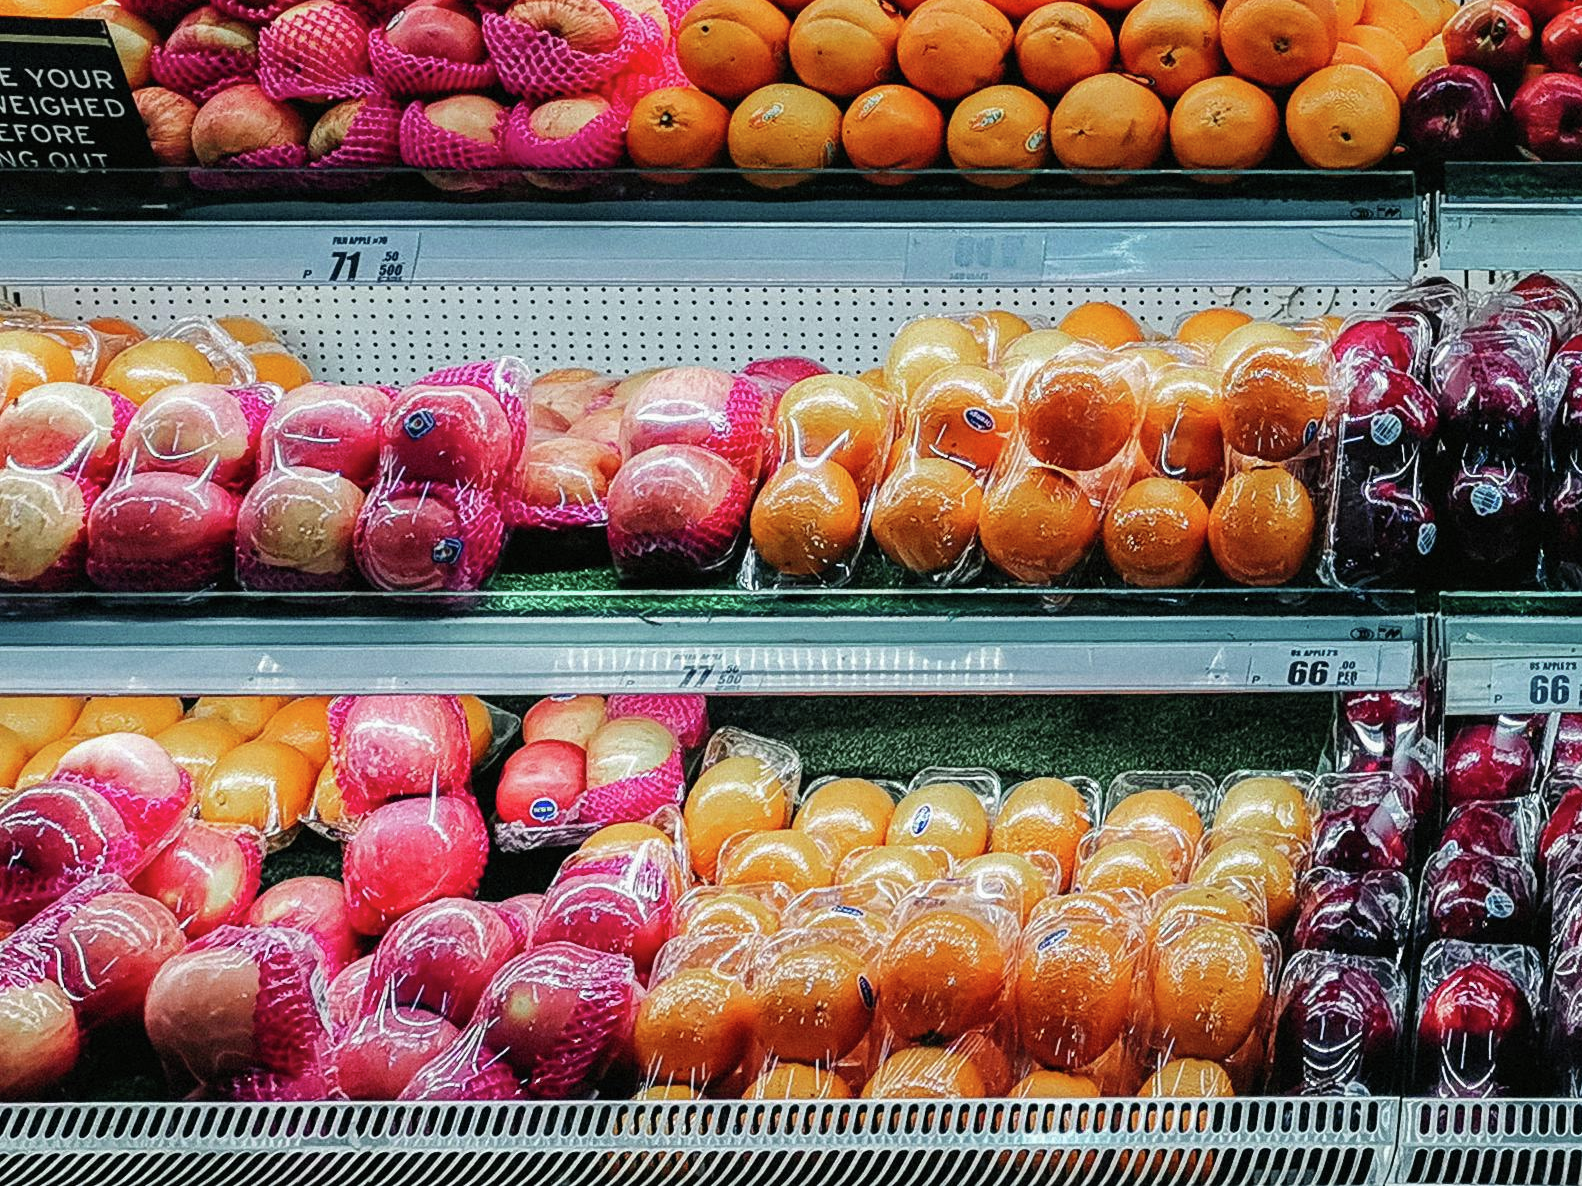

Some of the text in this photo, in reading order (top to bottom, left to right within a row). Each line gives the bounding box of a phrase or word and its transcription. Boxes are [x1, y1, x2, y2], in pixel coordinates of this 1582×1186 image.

[24, 68, 115, 89] YOUR
[48, 151, 108, 174] OUT
[348, 236, 370, 245] APPLE
[302, 251, 399, 282] P 71 .50
[378, 264, 403, 276] 500
[1303, 649, 1326, 657] APPLE
[1252, 675, 1261, 683] P
[1287, 660, 1330, 686] 66
[1339, 660, 1356, 670] .00
[1542, 661, 1565, 671] APPLE
[678, 664, 715, 688] 77
[717, 674, 742, 685] 500
[1338, 670, 1358, 682] PER
[1494, 694, 1503, 703] P
[1529, 674, 1570, 705] 66
